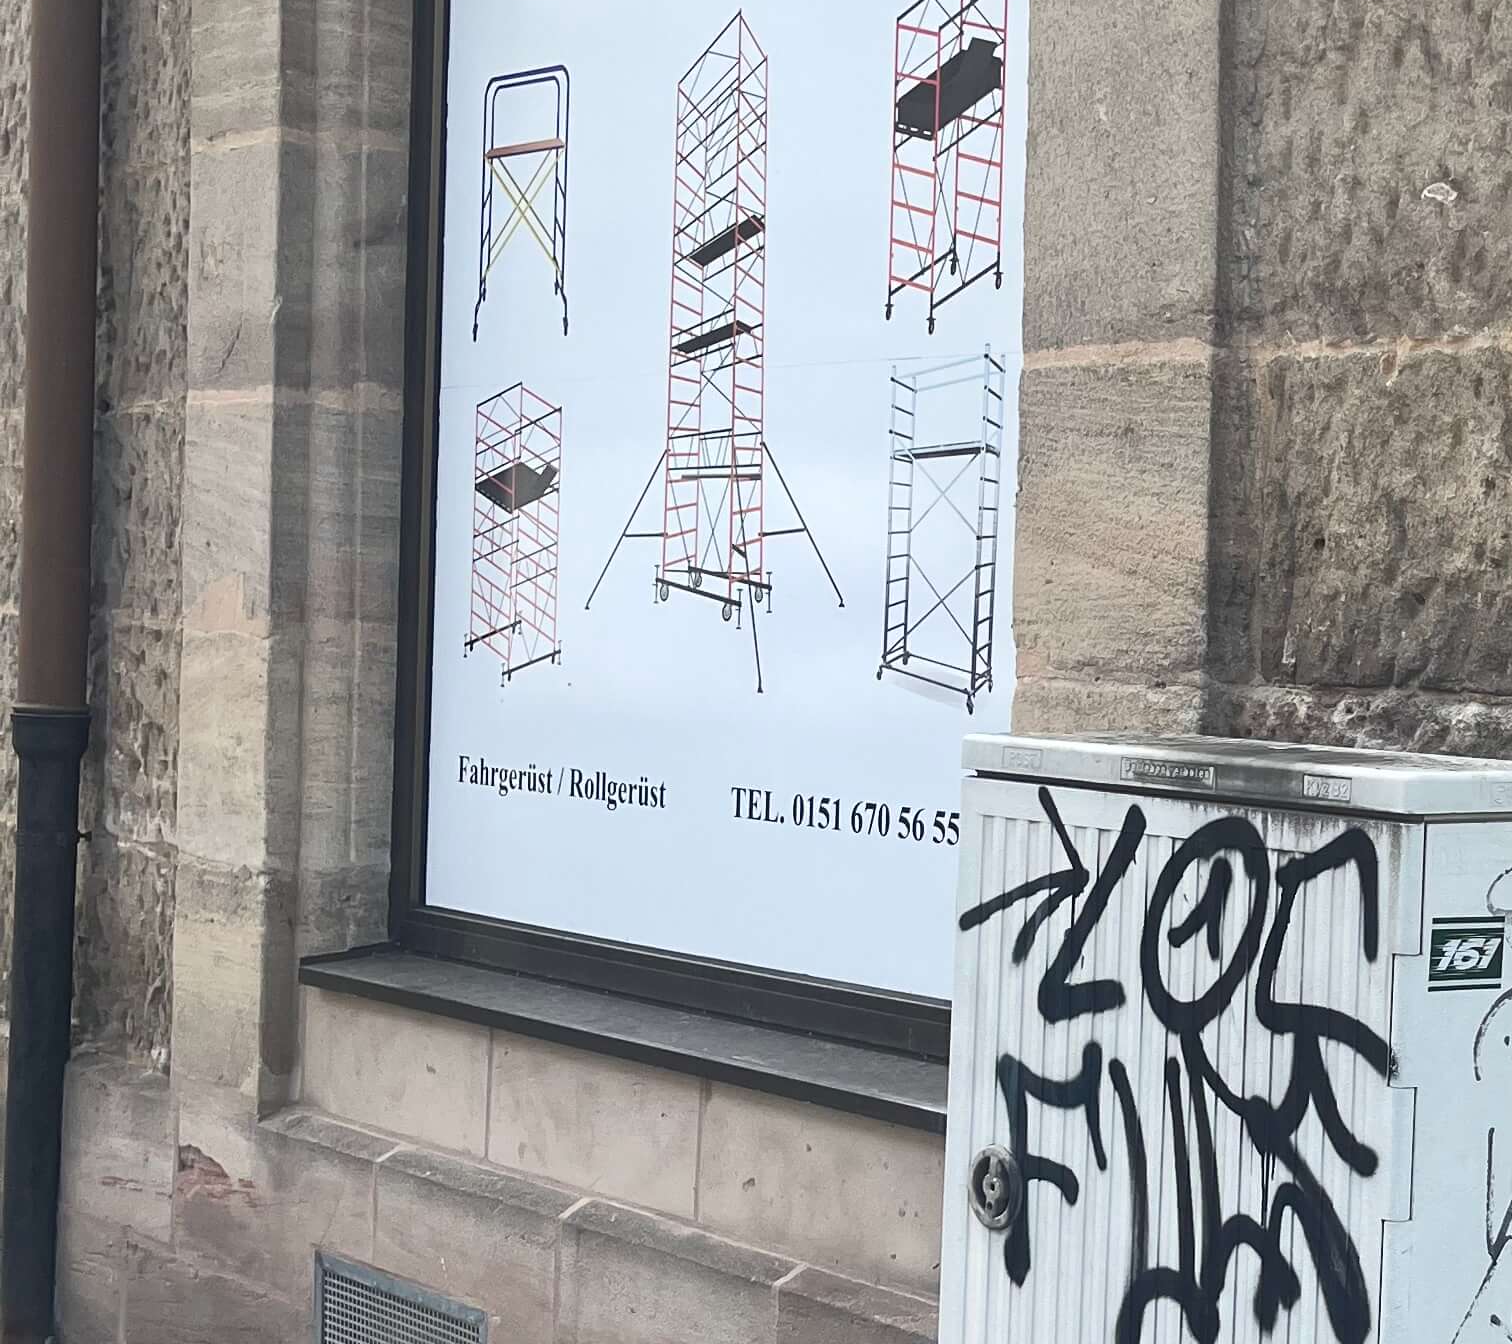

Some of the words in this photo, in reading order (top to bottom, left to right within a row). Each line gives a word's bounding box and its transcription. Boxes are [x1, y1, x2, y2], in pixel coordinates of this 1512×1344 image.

[458, 755, 552, 796] Fahrgerüst
[570, 768, 667, 810] Rollgerüst
[731, 786, 785, 824] TEL.
[792, 793, 841, 831] 0151
[851, 801, 890, 837] 670
[898, 806, 925, 841] 56
[932, 810, 960, 845] 55
